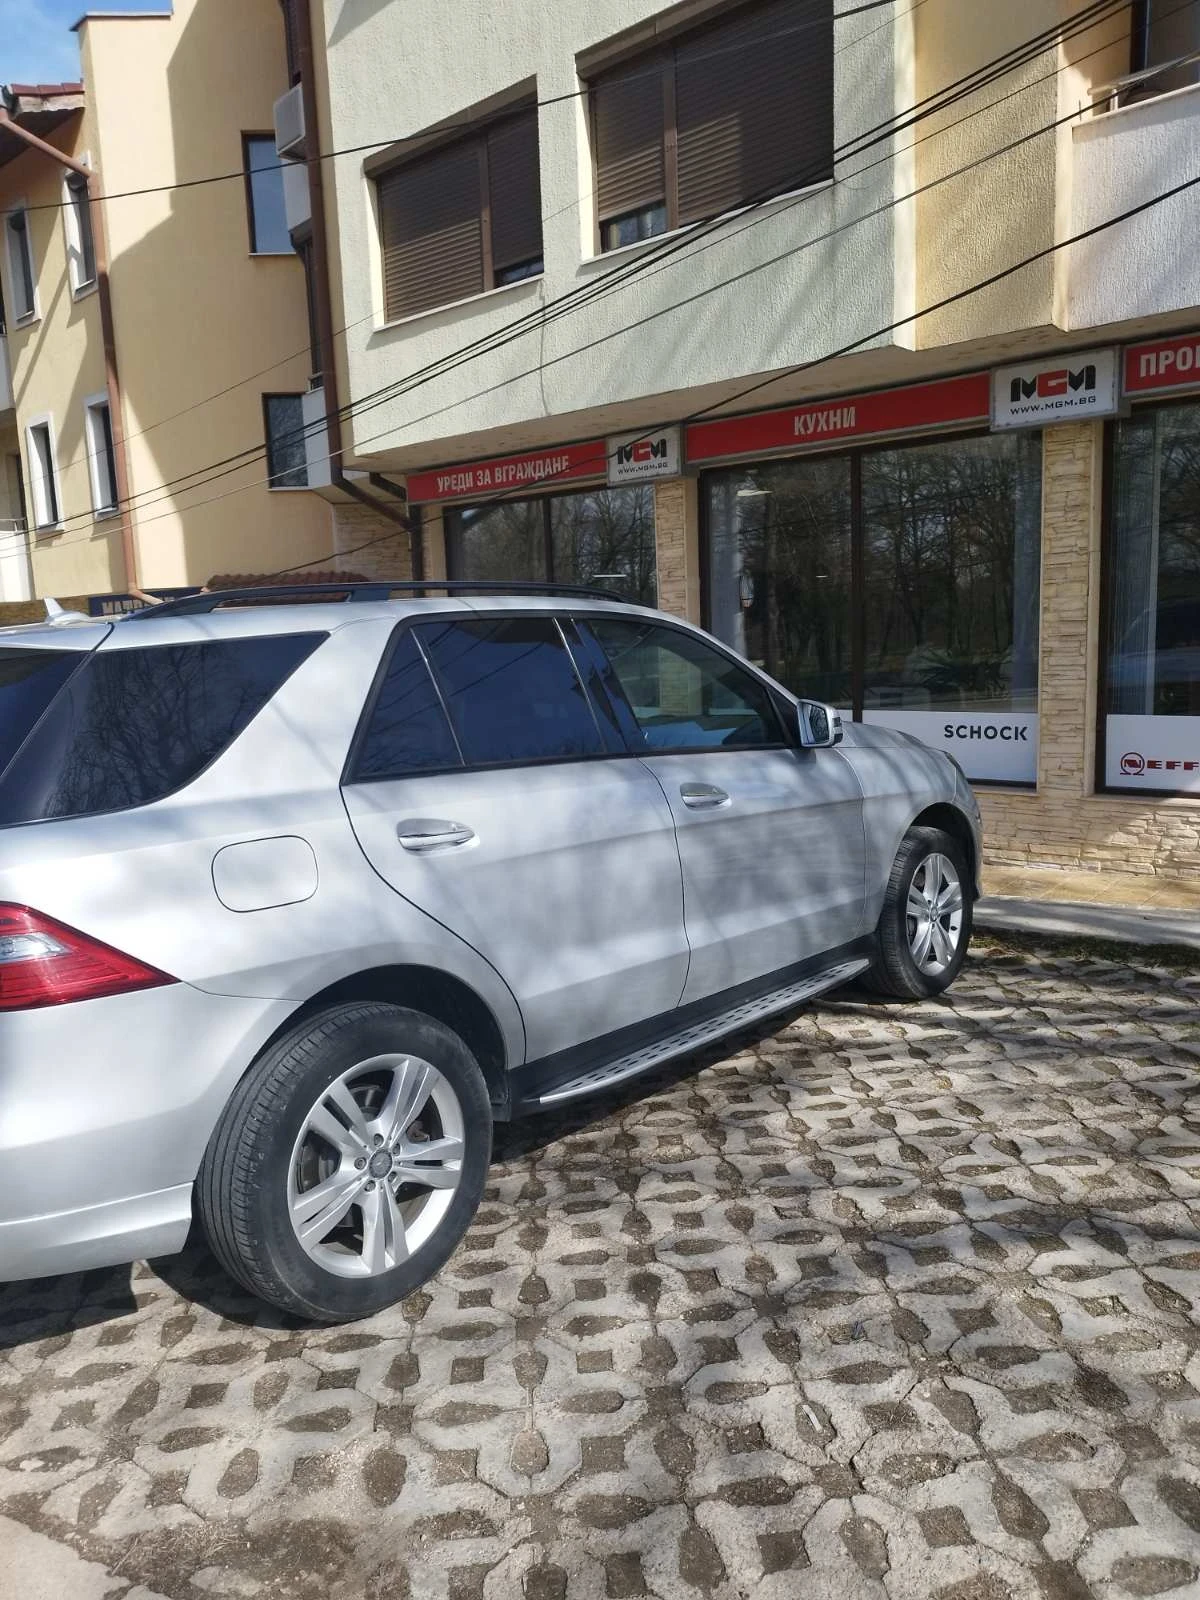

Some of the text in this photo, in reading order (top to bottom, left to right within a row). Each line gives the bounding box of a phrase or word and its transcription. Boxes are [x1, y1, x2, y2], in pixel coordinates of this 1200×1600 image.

[1010, 365, 1096, 402] MGM
[1010, 396, 1096, 415] WWW.MGM.BG
[794, 406, 856, 436] КУХНИ
[617, 439, 667, 464] MGM
[437, 455, 570, 492] УРЕДИ ЗА ВГРАЖДАНЕ
[944, 724, 1028, 741] SCHOCK
